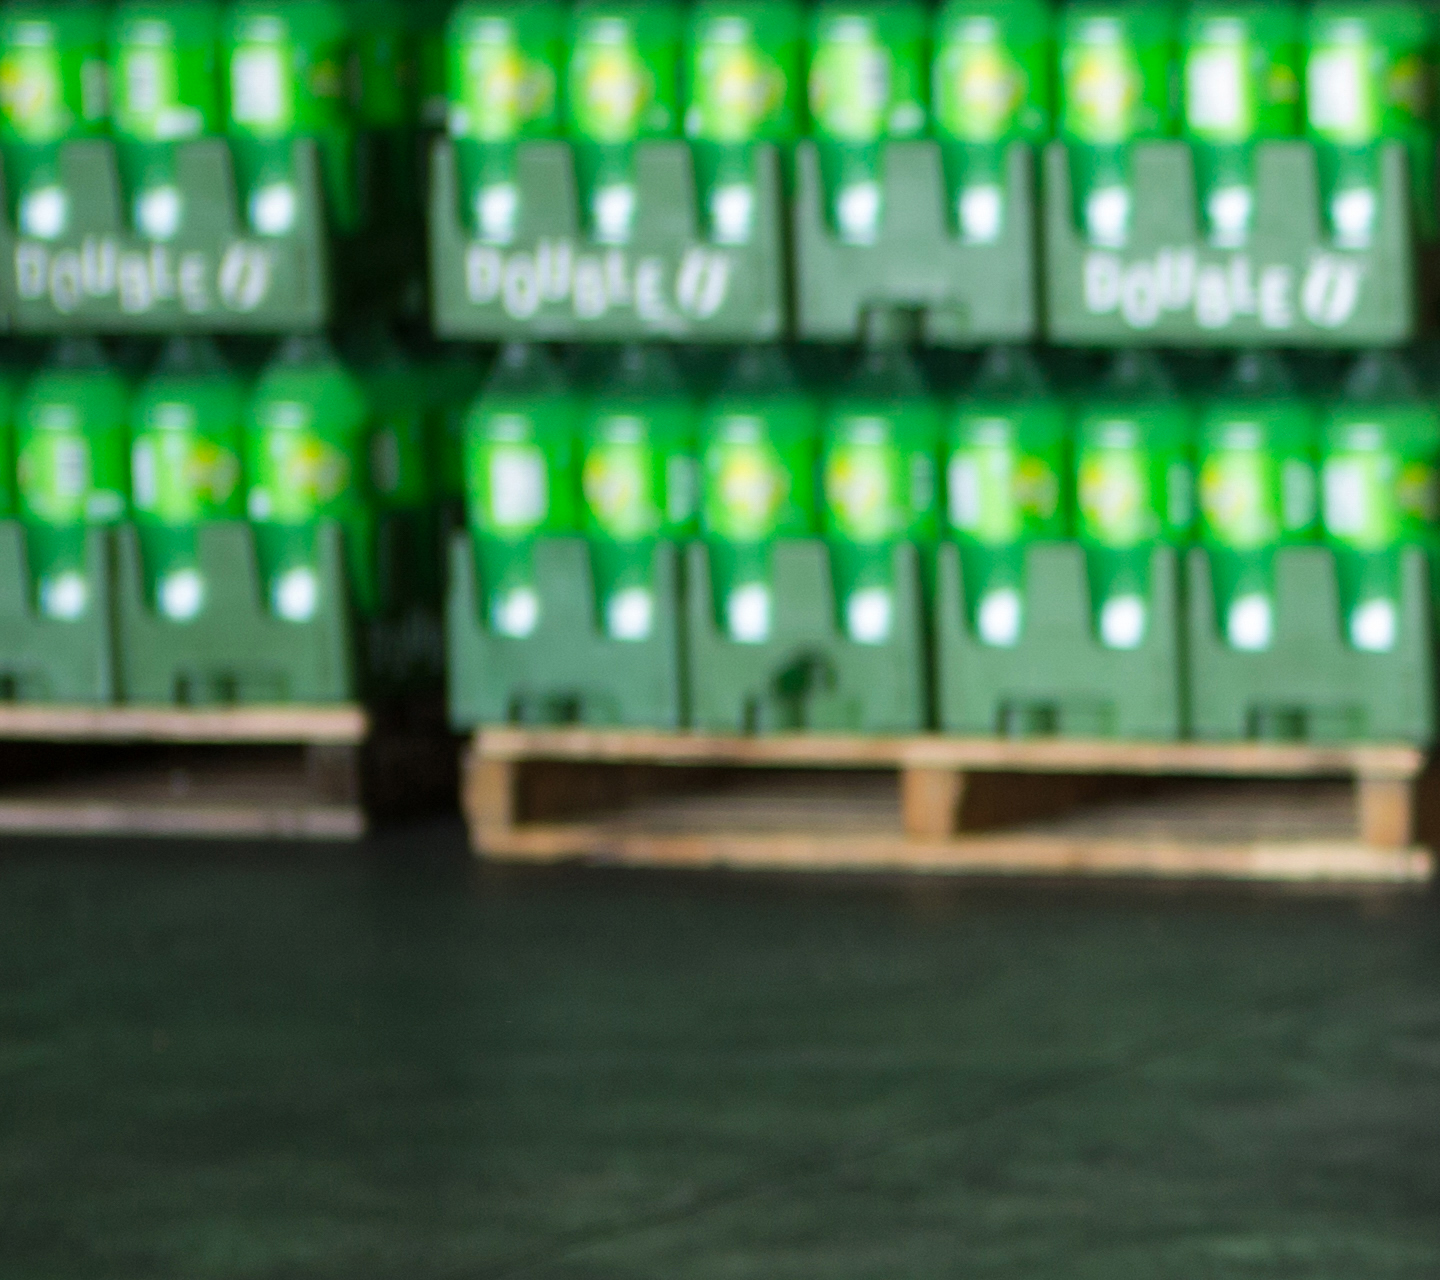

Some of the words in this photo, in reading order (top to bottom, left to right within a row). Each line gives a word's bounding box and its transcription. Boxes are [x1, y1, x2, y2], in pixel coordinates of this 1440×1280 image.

[14, 232, 209, 315] DOUBLE
[464, 235, 664, 321] DOUBLE
[1083, 244, 1293, 330] DOUBLE
